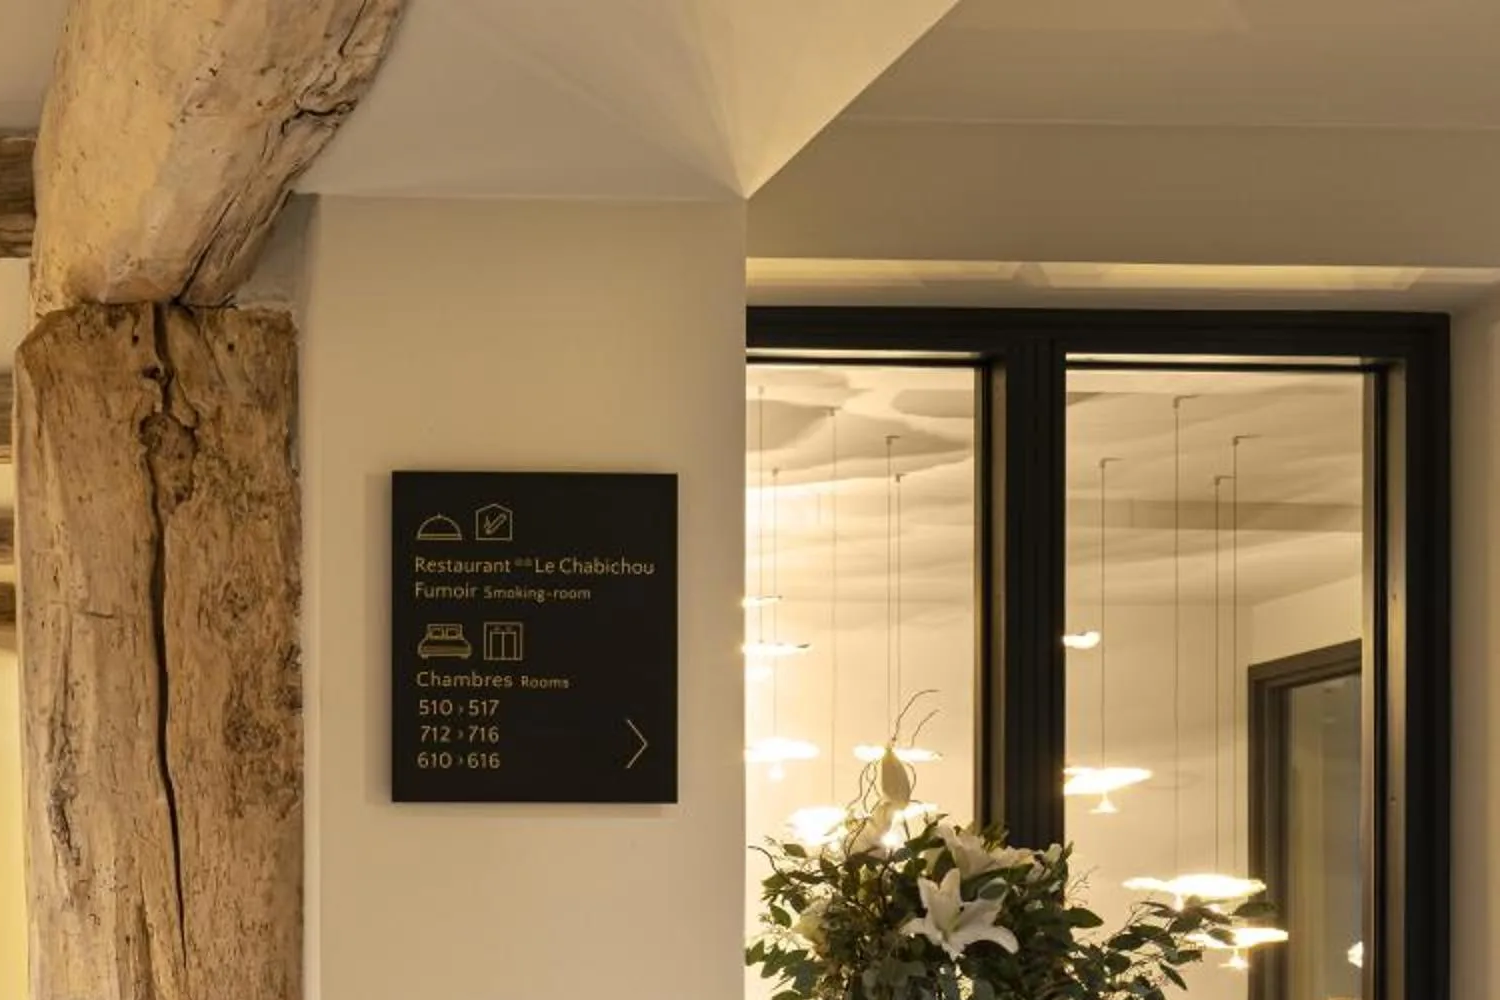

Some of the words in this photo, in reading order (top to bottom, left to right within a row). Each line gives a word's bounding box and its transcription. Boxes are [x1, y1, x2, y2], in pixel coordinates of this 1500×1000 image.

[414, 556, 511, 574] Restaurant
[534, 558, 555, 574] Le
[559, 557, 656, 576] Chabichou
[414, 583, 477, 600] Fumoir
[483, 586, 591, 603] Smoking-room
[416, 671, 513, 689] Chambres
[521, 675, 570, 690] Rooms
[418, 699, 453, 717] 510
[468, 699, 501, 717] 517
[420, 726, 451, 744] 712
[468, 726, 500, 744] 716
[417, 752, 453, 770] 610
[467, 752, 501, 770] 616
